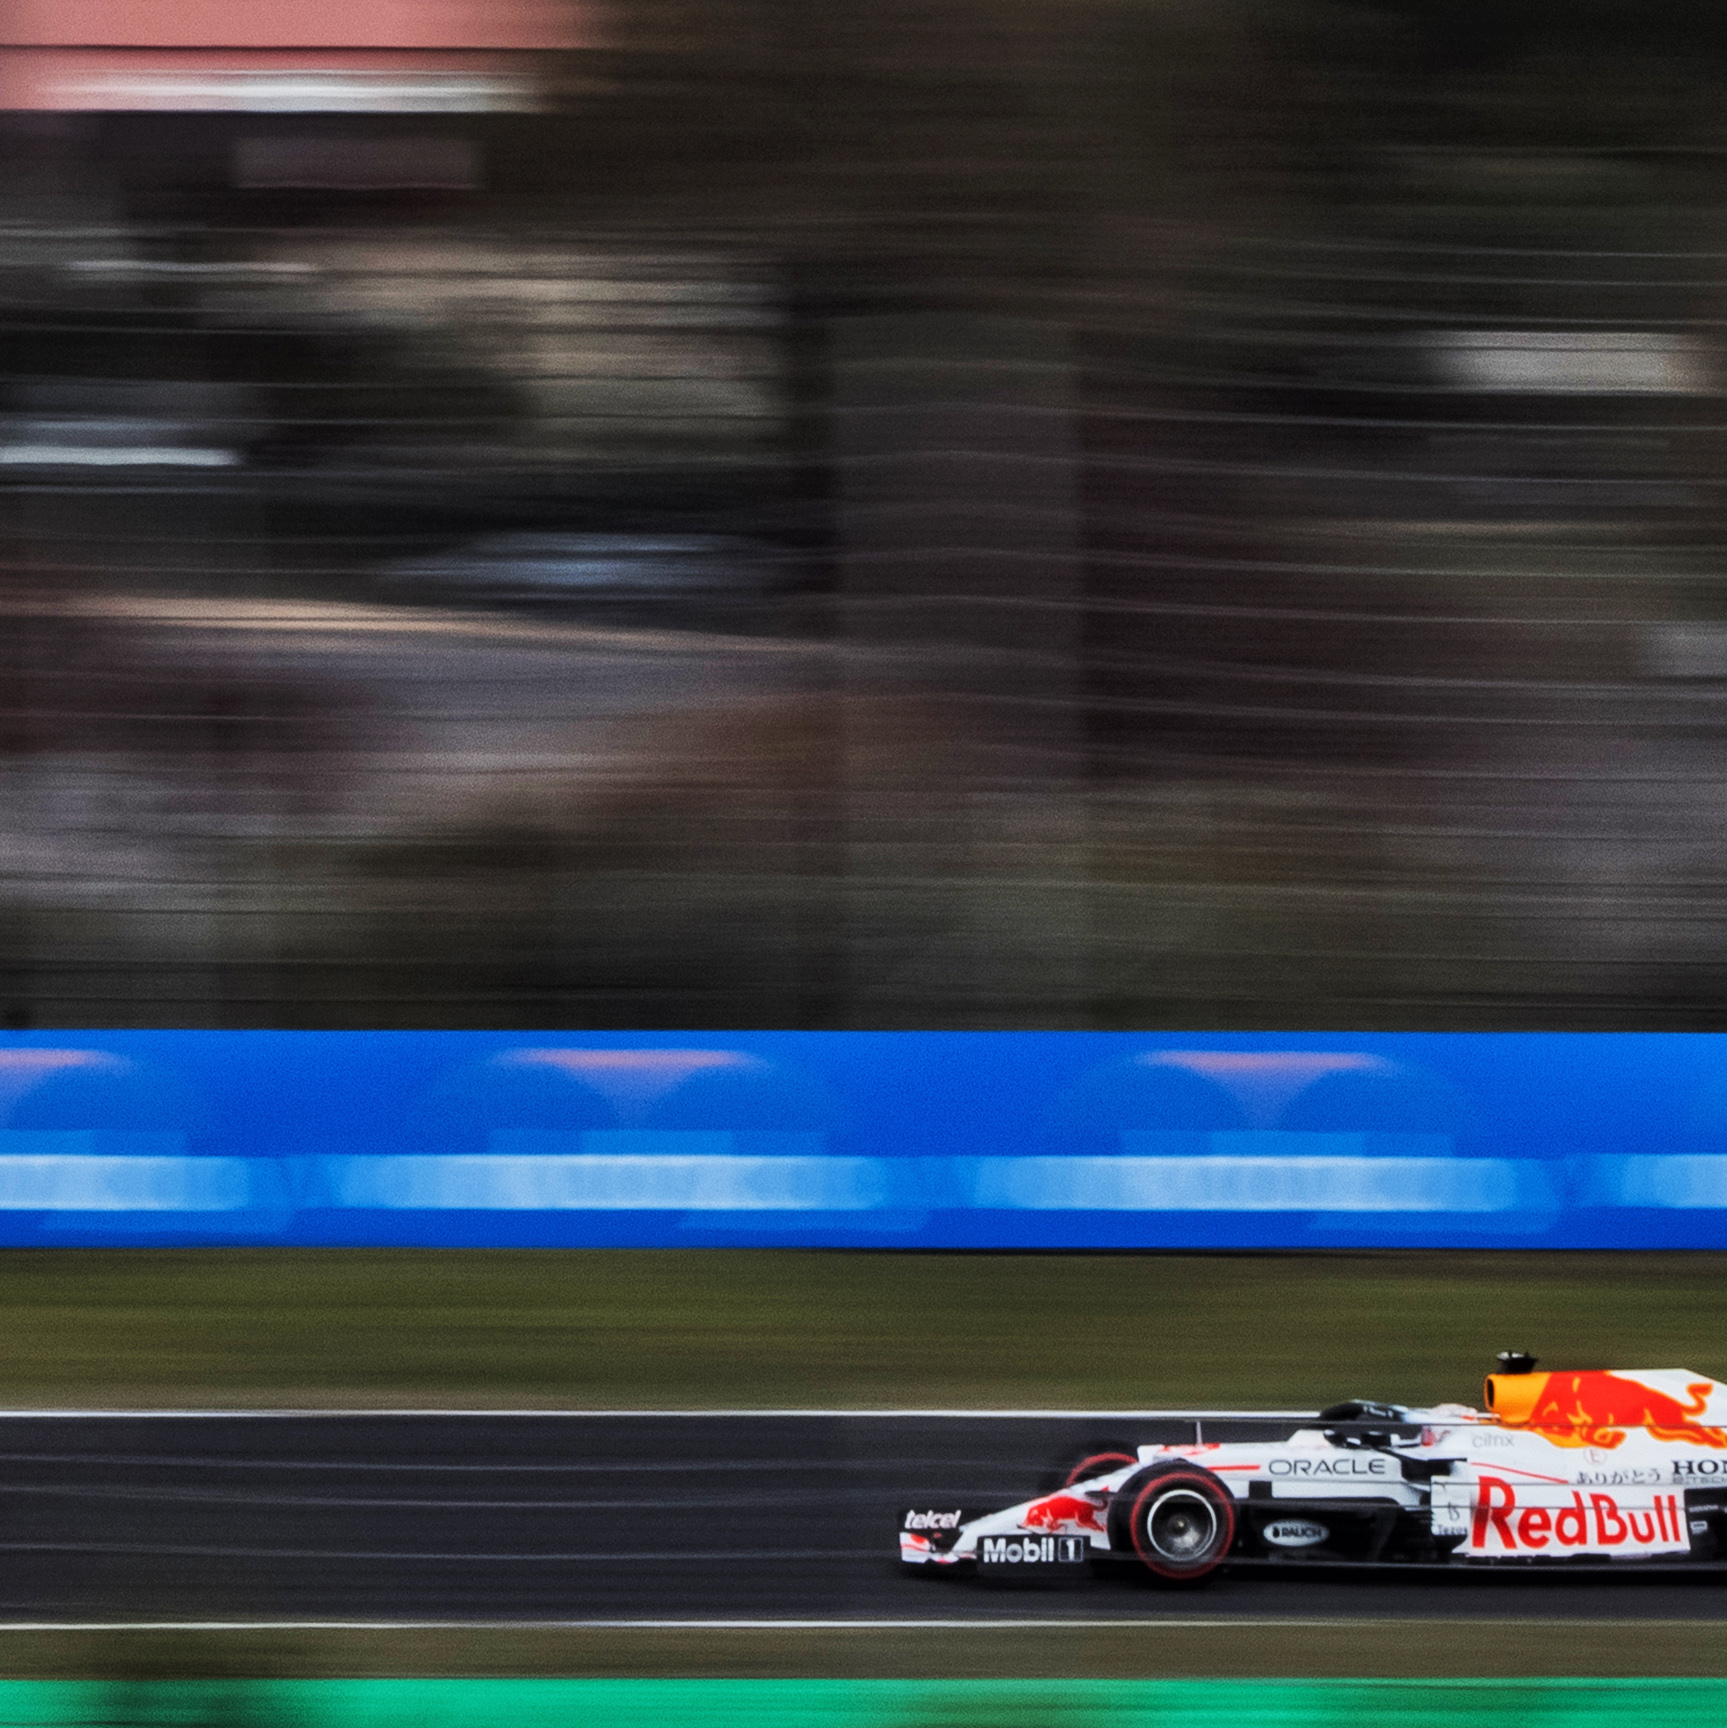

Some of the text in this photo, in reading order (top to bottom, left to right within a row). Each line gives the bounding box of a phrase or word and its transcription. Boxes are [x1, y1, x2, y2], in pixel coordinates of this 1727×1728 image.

[1269, 1458, 1386, 1475] ORACLE
[904, 1509, 962, 1529] telcel
[983, 1537, 1054, 1563] Mobil
